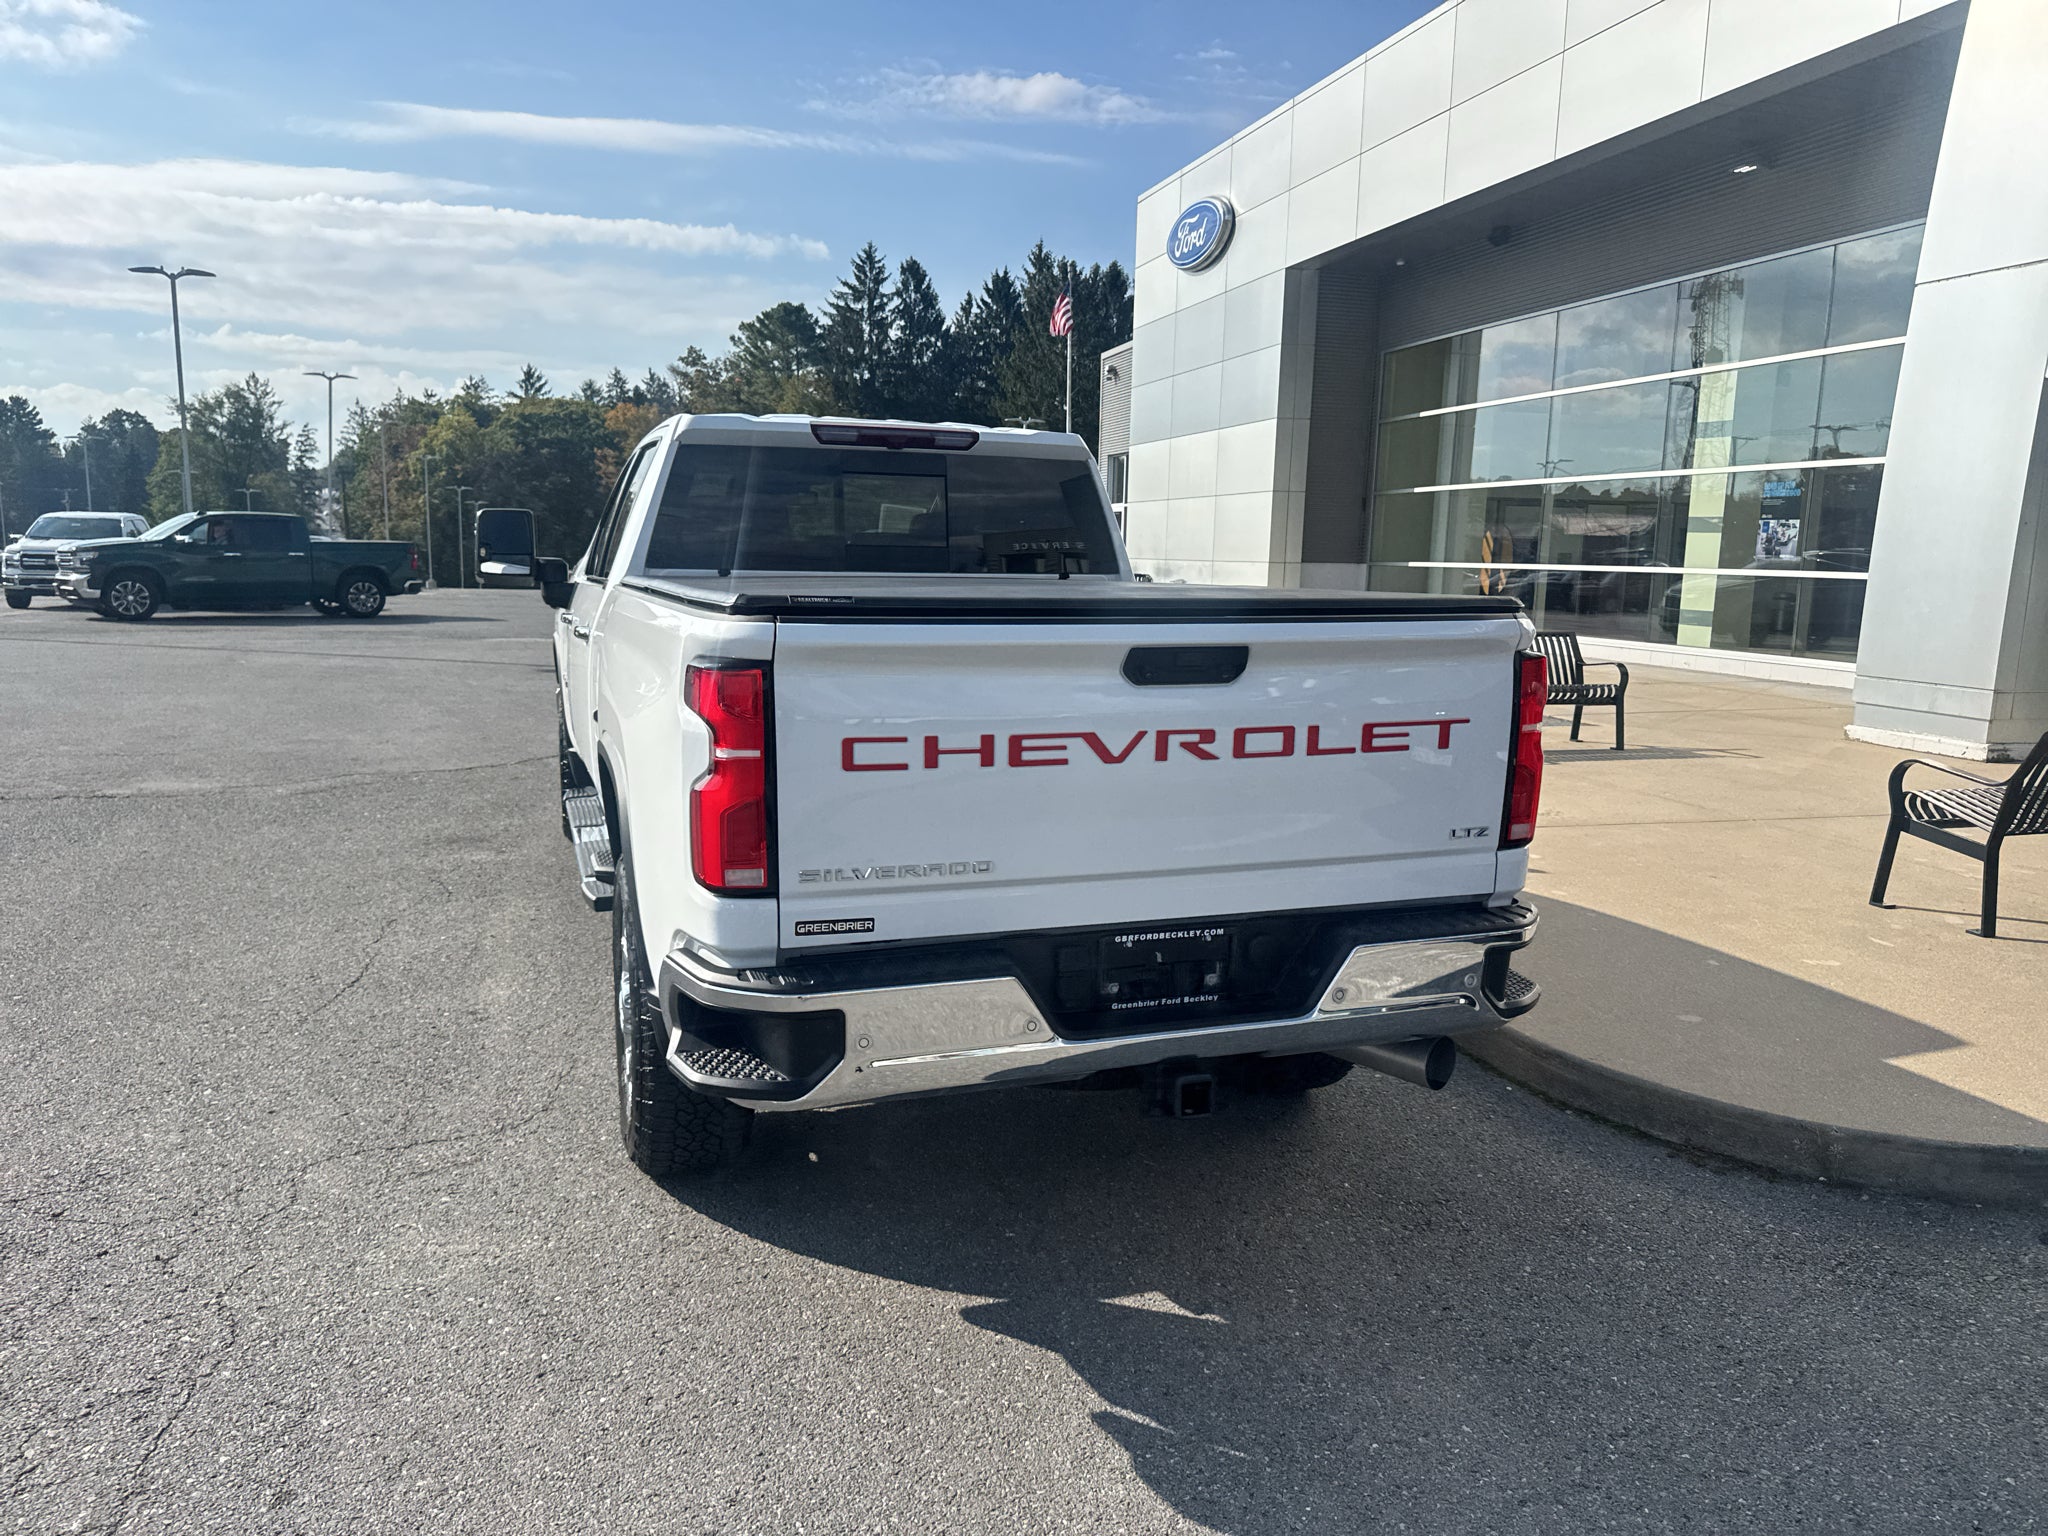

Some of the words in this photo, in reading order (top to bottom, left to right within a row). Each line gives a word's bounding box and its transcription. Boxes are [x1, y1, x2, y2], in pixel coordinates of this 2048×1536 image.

[1174, 213, 1208, 258] Ford
[841, 718, 1470, 772] CHEVROLET
[1449, 826, 1489, 840] LTZ
[798, 860, 994, 884] SILVERADO
[796, 920, 874, 933] GREENBRIER
[1115, 928, 1225, 943] GBRFORDBECKLEY.COM
[1111, 1000, 1159, 1010] Greenbrier
[1161, 997, 1181, 1005] Ford
[1183, 994, 1219, 1003] Beckley
